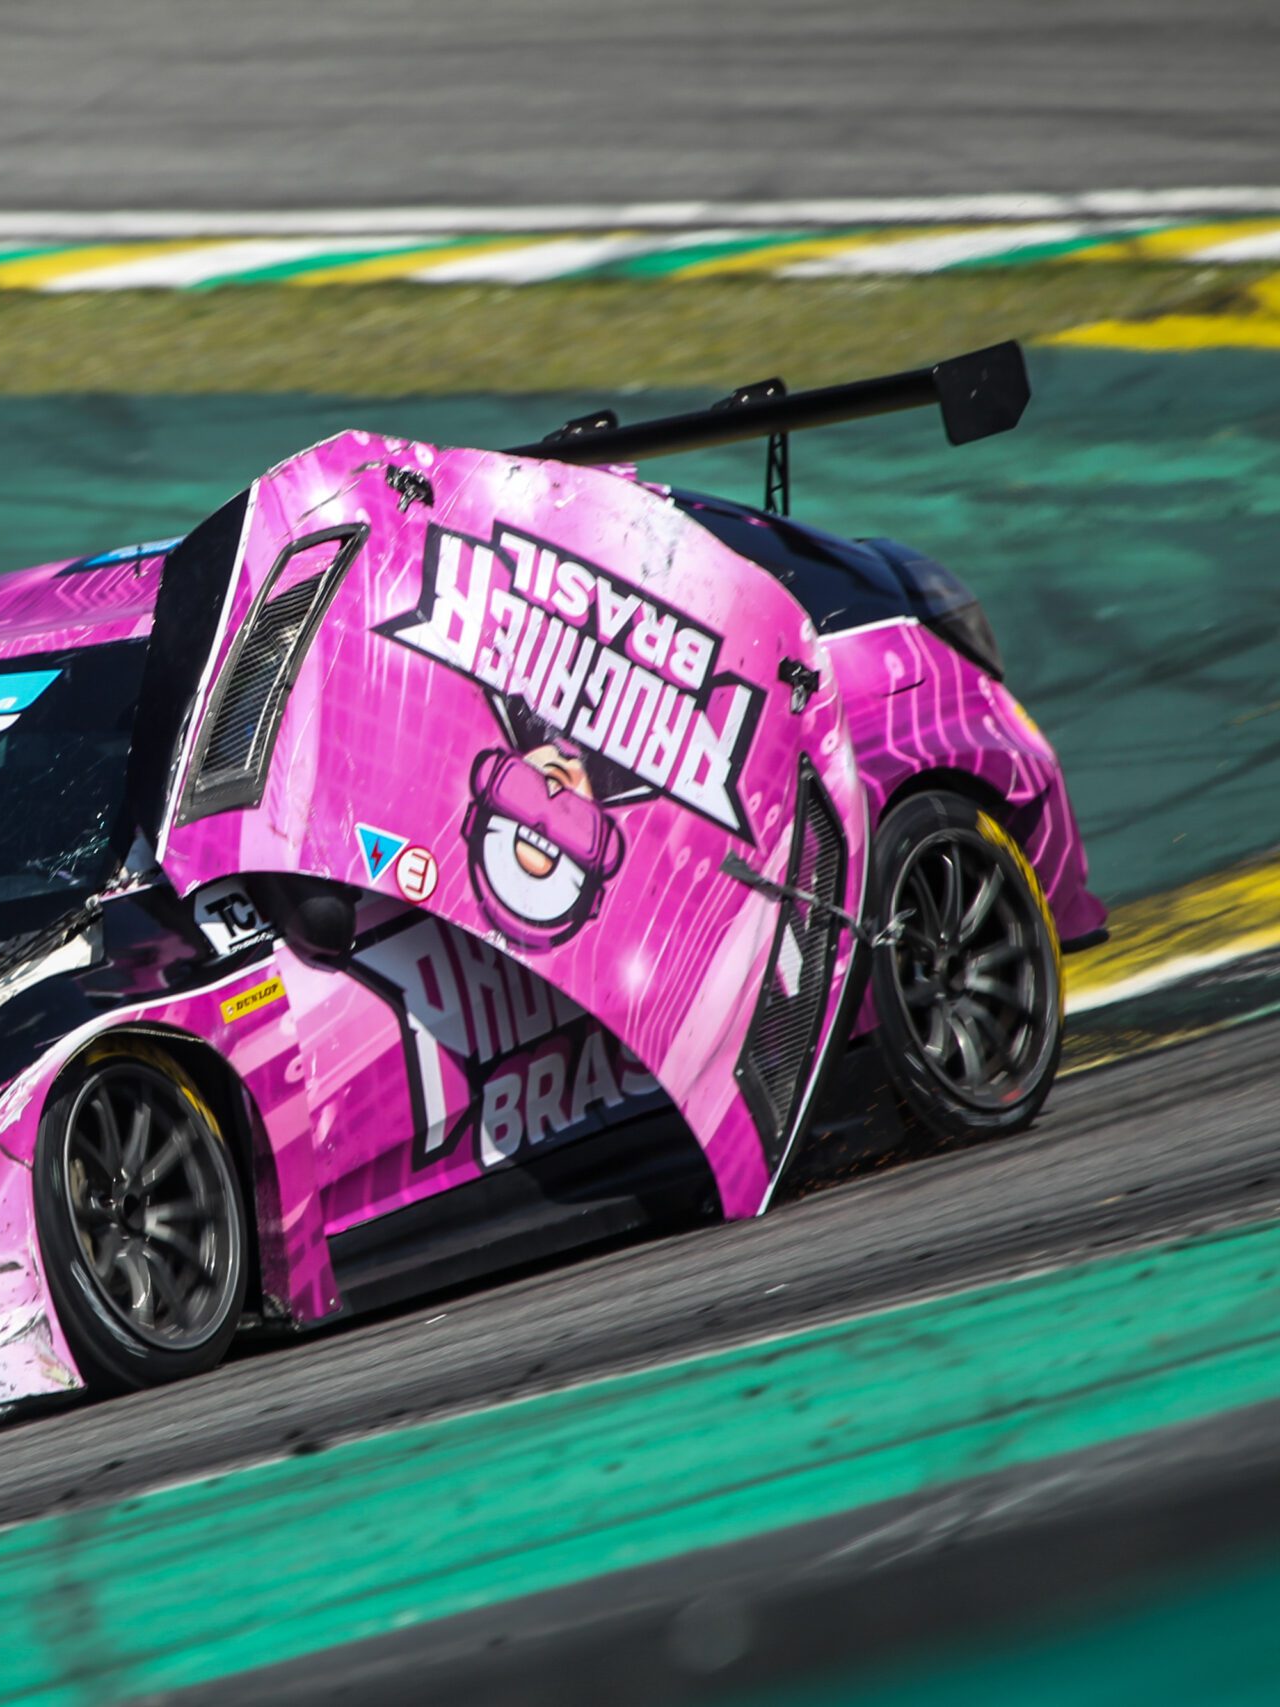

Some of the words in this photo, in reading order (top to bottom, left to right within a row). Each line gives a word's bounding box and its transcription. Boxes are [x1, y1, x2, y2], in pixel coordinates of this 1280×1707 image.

[498, 532, 716, 690] BRASIL
[393, 533, 753, 832] PROGAMER
[204, 893, 272, 937] TC
[236, 983, 278, 1011] DUNLOP
